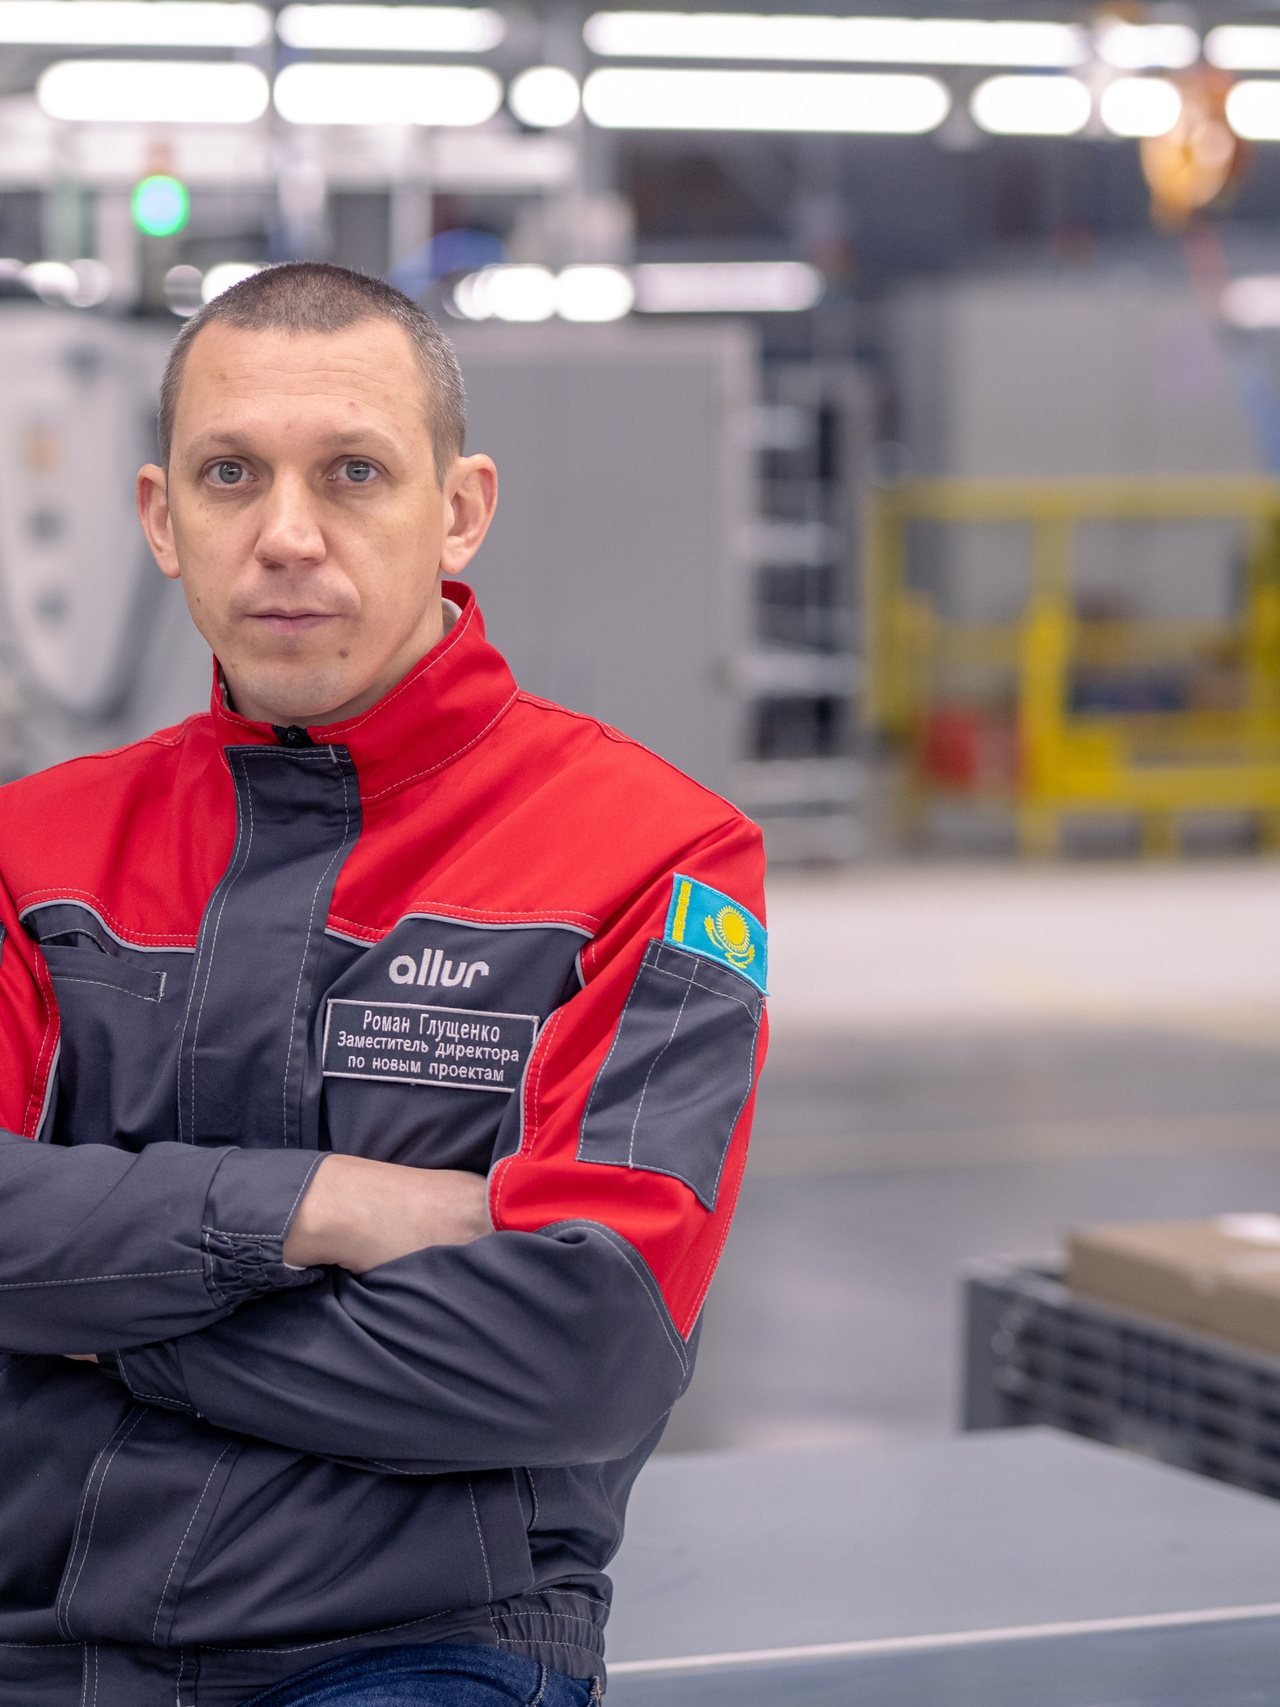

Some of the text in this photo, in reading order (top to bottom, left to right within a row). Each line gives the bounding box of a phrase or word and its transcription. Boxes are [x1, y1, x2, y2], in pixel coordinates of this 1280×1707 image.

[389, 948, 490, 988] allur
[363, 1009, 500, 1043] Роман Глущенко
[337, 1030, 519, 1065] Заместитель директора
[348, 1055, 504, 1082] по новым проектам
